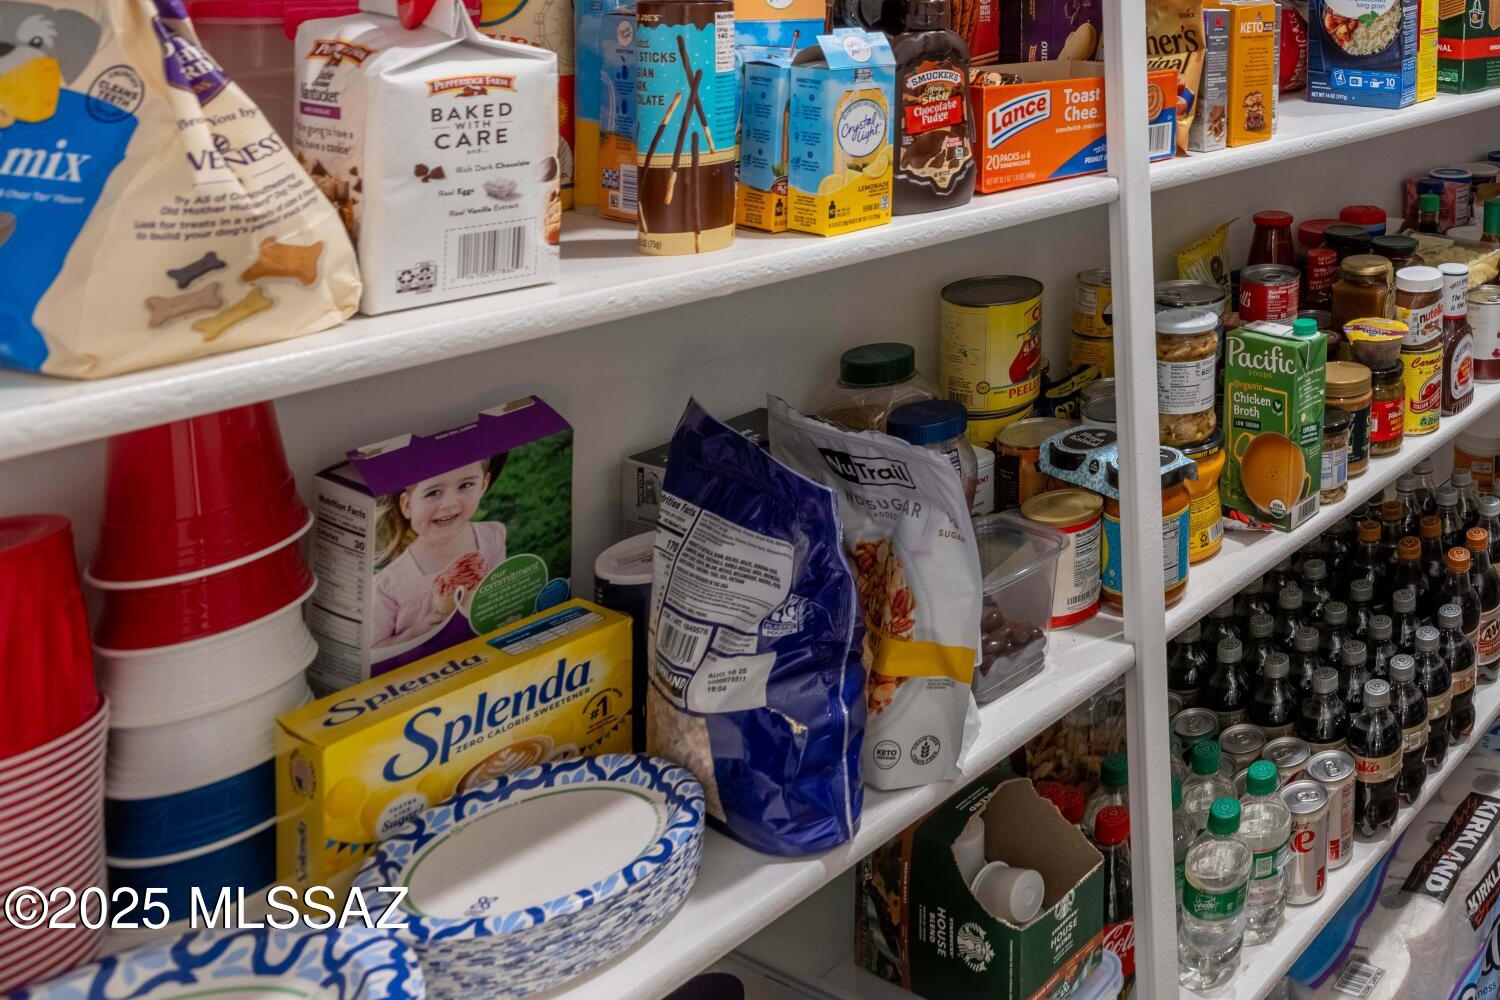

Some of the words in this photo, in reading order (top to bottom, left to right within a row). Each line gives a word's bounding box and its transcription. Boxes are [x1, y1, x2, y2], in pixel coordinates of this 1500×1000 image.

[1240, 21, 1263, 34] KETO
[639, 52, 676, 63] STICKS
[433, 77, 483, 91] PEPPERIDGE
[486, 76, 509, 89] FARM
[911, 70, 960, 86] SMUCKER'S
[1386, 78, 1396, 88] 10
[1064, 88, 1101, 105] Toast
[432, 103, 513, 122] BAKED
[914, 99, 957, 117] Chocolate
[991, 97, 1047, 136] Lance
[456, 120, 491, 130] WITH
[841, 112, 876, 140] Crystal
[922, 111, 948, 125] Fudge
[434, 128, 508, 149] CARE
[1055, 125, 1082, 134] sandwich
[1, 140, 91, 183] mix
[986, 155, 1000, 171] 20
[1000, 153, 1020, 162] PACKS
[858, 181, 889, 193] LEMONADE
[647, 240, 662, 250] (75g)
[1226, 336, 1297, 375] Pacific
[1234, 380, 1264, 391] Organic
[1234, 392, 1271, 407] Chicken
[1234, 405, 1259, 418] Broth
[825, 454, 908, 482] NuTrail
[347, 504, 366, 519] Facts
[681, 503, 696, 517] Facts
[865, 498, 921, 518] SUGAR
[353, 540, 365, 550] 30
[479, 562, 539, 594] commitment
[323, 654, 485, 728] Splenda
[590, 695, 612, 721] #1
[382, 658, 592, 782] Splenda
[455, 736, 485, 753] ZERO
[487, 713, 531, 740] CALORIE
[533, 687, 591, 718] SWEETENER
[382, 804, 426, 833] Sugar!
[937, 906, 947, 958] HOUSE
[1051, 917, 1078, 946] HOUSE
[1056, 932, 1072, 952] BLEND
